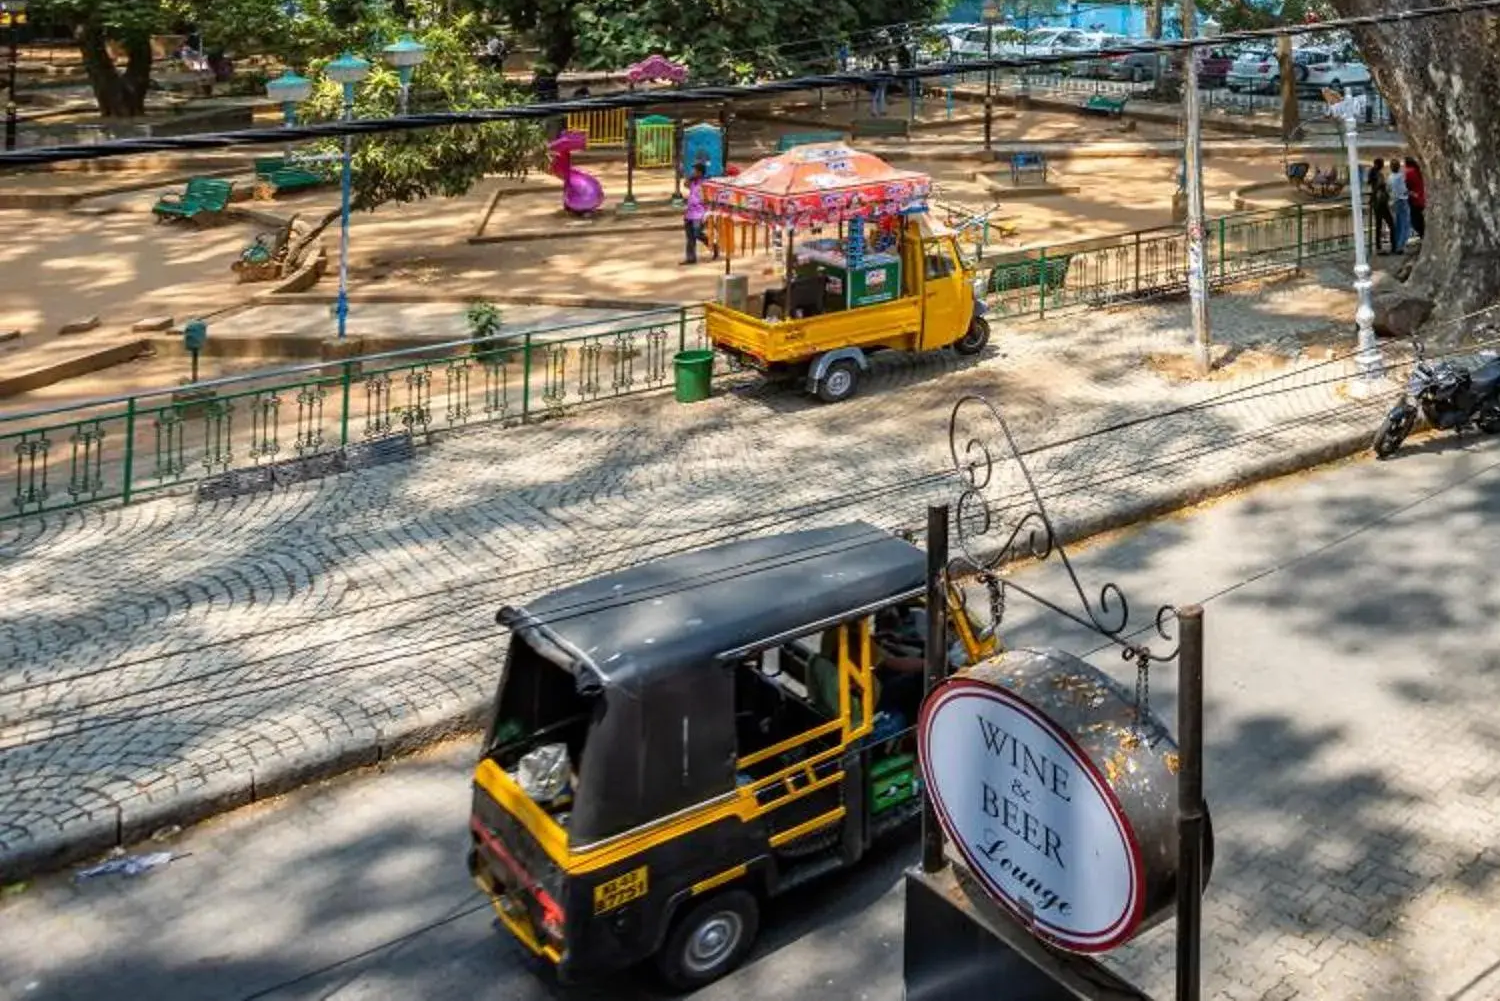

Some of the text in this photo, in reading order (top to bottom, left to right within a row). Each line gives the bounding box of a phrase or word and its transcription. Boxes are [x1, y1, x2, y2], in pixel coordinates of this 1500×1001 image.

[976, 715, 1072, 802] WINE
[1011, 780, 1032, 804] &
[981, 784, 1066, 868] BEER
[975, 830, 1073, 917] Lounge
